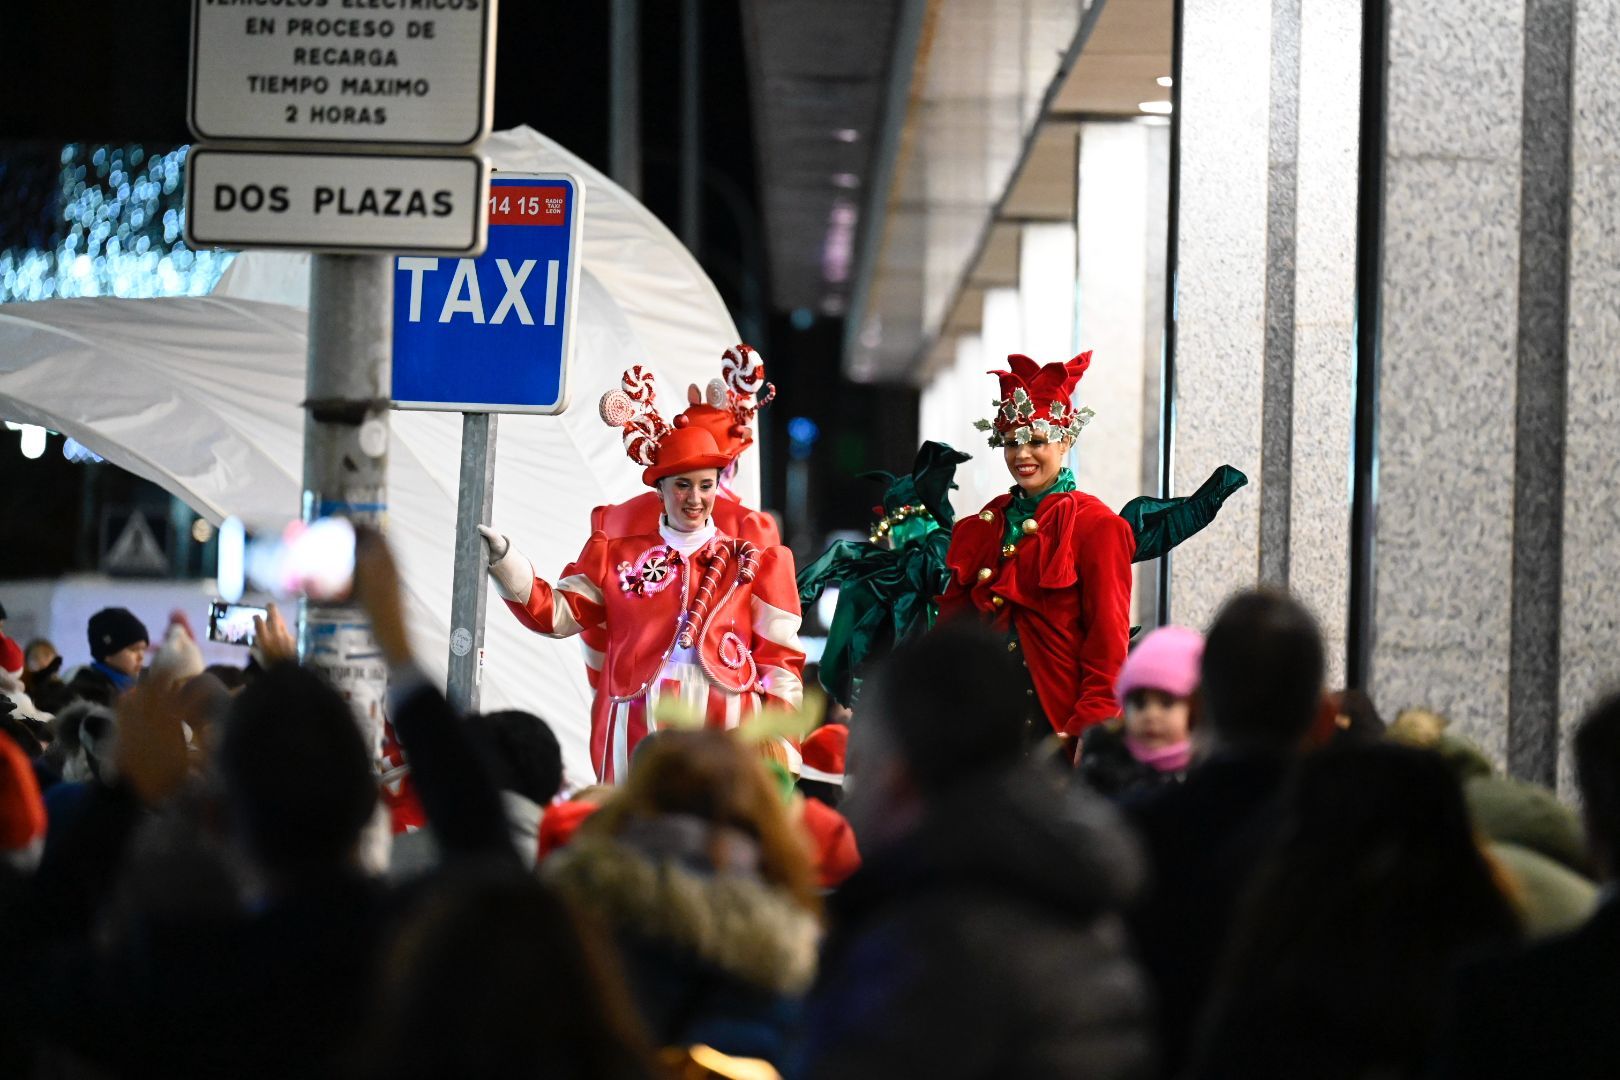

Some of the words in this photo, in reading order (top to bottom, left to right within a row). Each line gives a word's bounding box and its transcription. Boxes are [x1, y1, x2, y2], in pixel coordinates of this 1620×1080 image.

[245, 17, 276, 36] EN
[286, 18, 394, 38] PROCESO
[407, 21, 435, 39] DE
[293, 47, 398, 67] RECARGA
[246, 75, 329, 95] TIEMPO
[341, 78, 429, 97] MAXIMO
[285, 105, 298, 123] 2
[310, 106, 387, 125] HORAS
[214, 184, 290, 214] DOS
[314, 187, 453, 217] PLAZAS
[489, 196, 511, 215] 14
[518, 197, 540, 216] 15
[398, 257, 560, 326] TAXI
